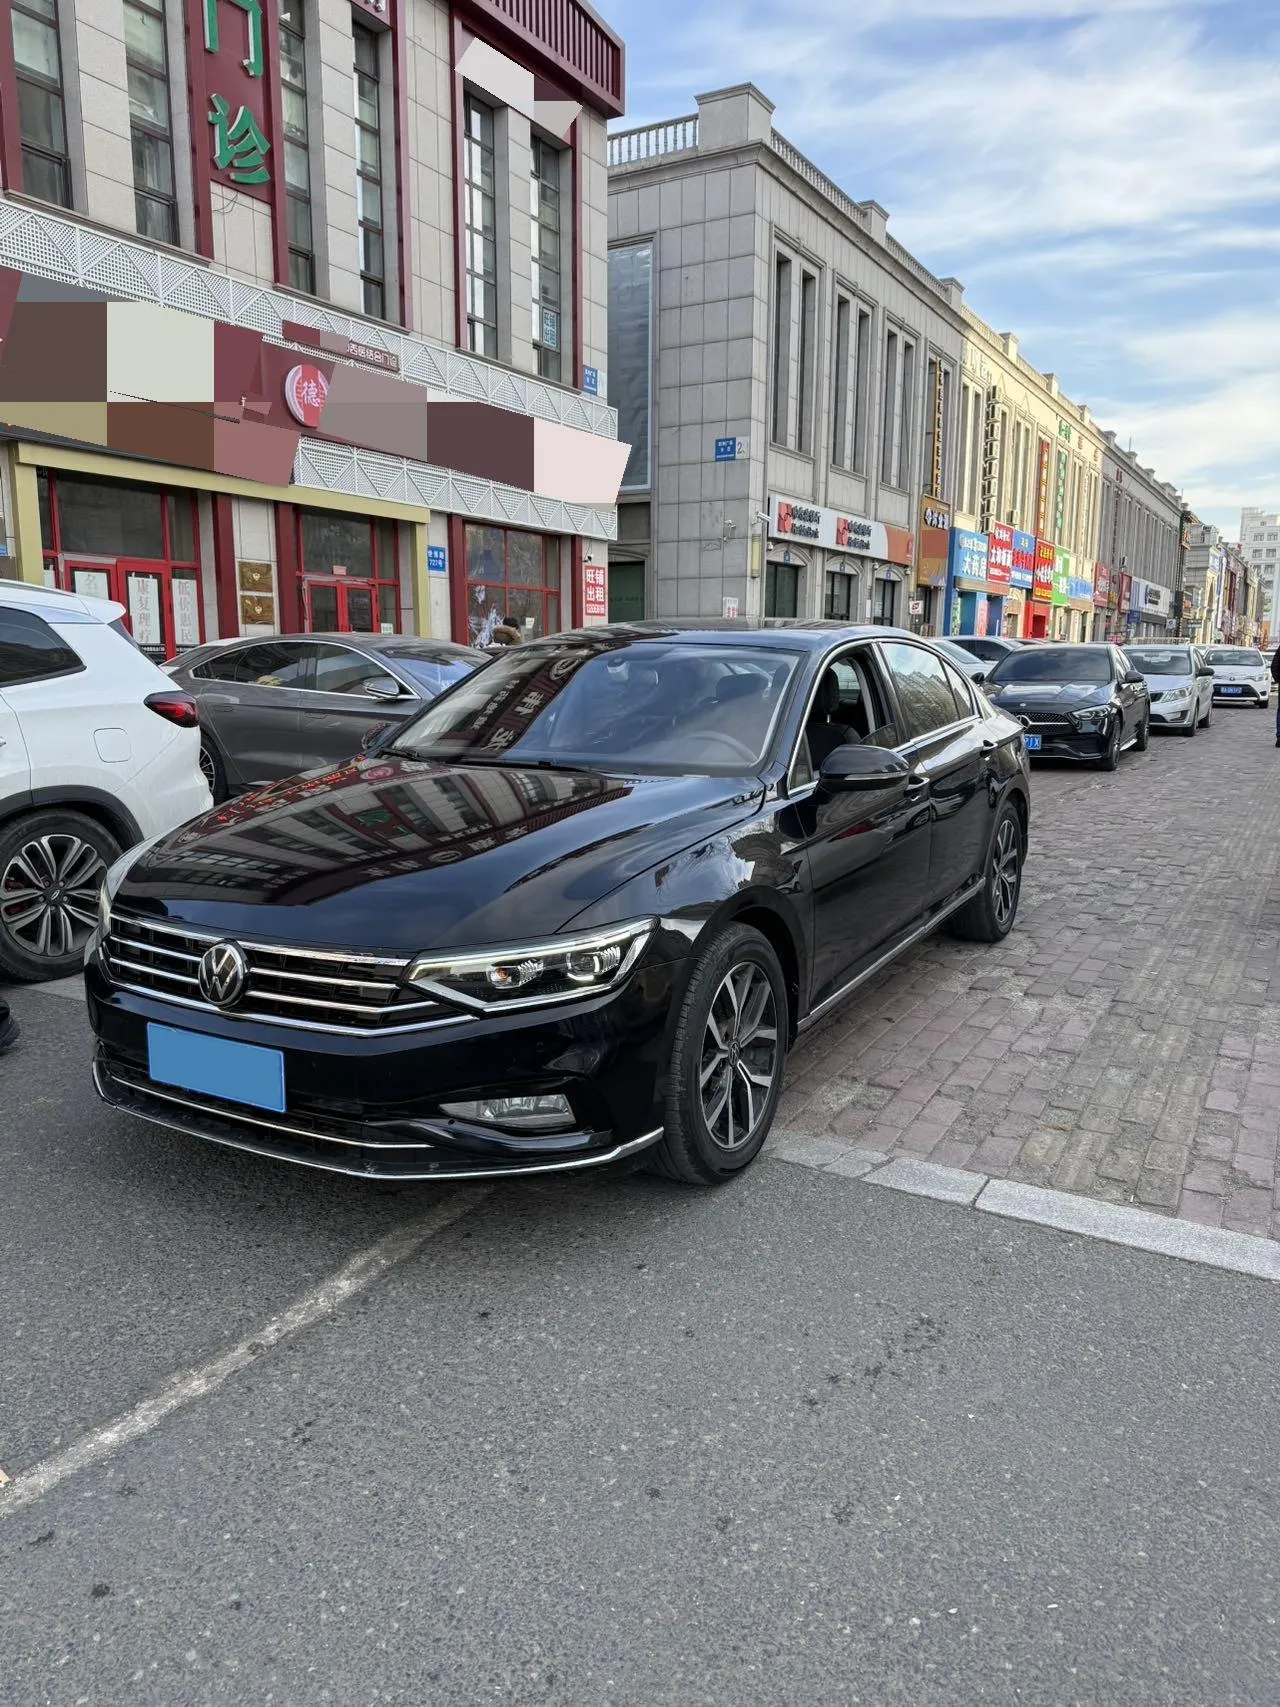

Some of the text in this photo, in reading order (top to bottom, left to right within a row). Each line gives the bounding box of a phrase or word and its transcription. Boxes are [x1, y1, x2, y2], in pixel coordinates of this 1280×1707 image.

[203, 0, 271, 183] 门诊
[301, 379, 321, 407] 德
[586, 568, 604, 585] 旺铺
[586, 585, 605, 602] 出租
[136, 578, 151, 643] 康复理疗
[178, 580, 193, 642] 低价惠民
